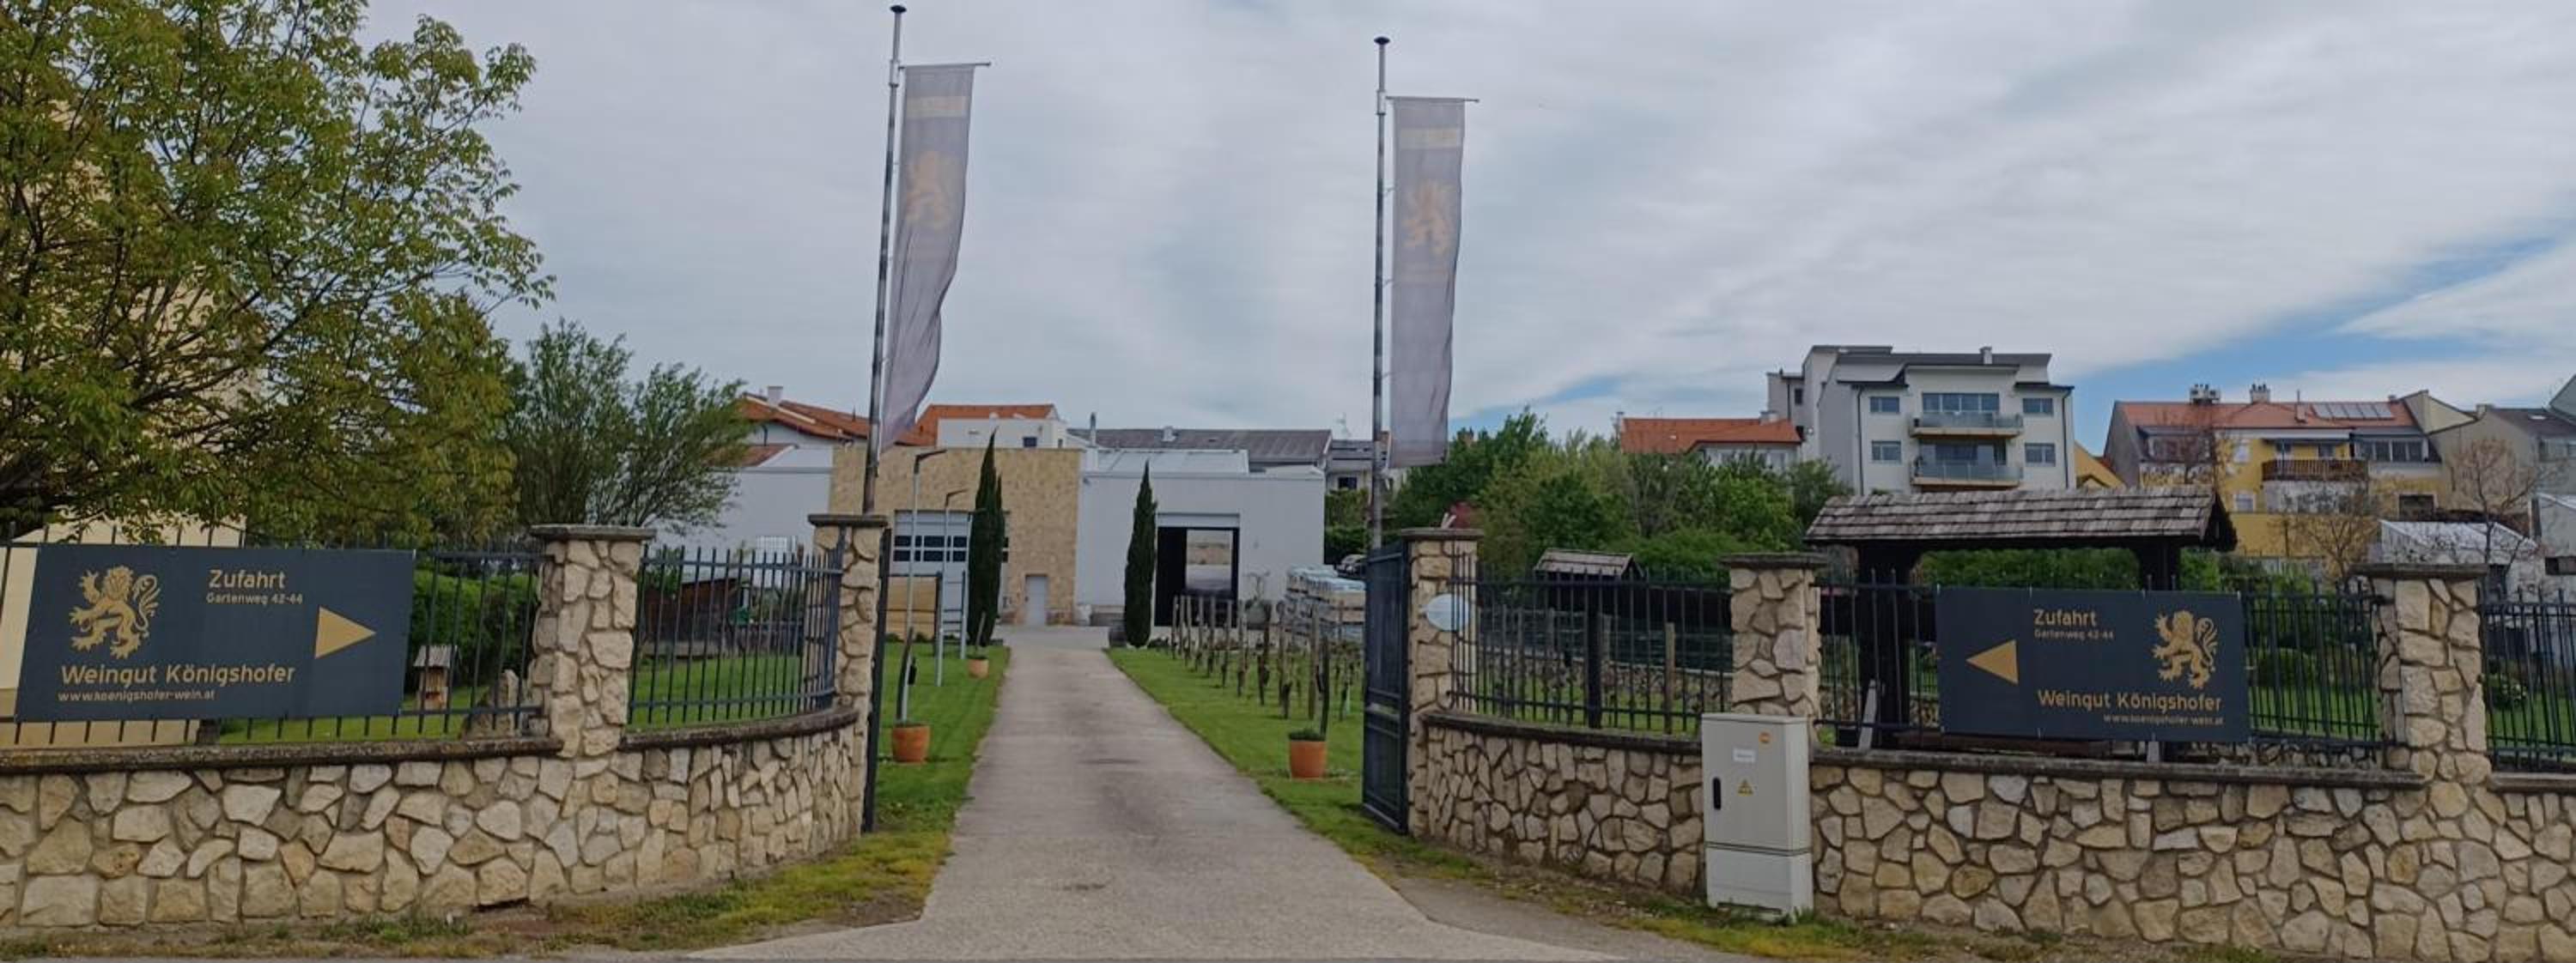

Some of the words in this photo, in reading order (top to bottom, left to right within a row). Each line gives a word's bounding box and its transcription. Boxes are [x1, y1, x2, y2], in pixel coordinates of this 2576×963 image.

[209, 569, 286, 590] Zufahrt
[206, 592, 269, 605] Gartenweg
[2033, 609, 2097, 627] Zufahrt
[60, 664, 157, 688] Weingut
[165, 663, 295, 687] Königshofer
[57, 689, 216, 703] www.koenigshofer-wein.at
[2038, 689, 2111, 712] Weingut
[2117, 691, 2222, 713] Königshofer
